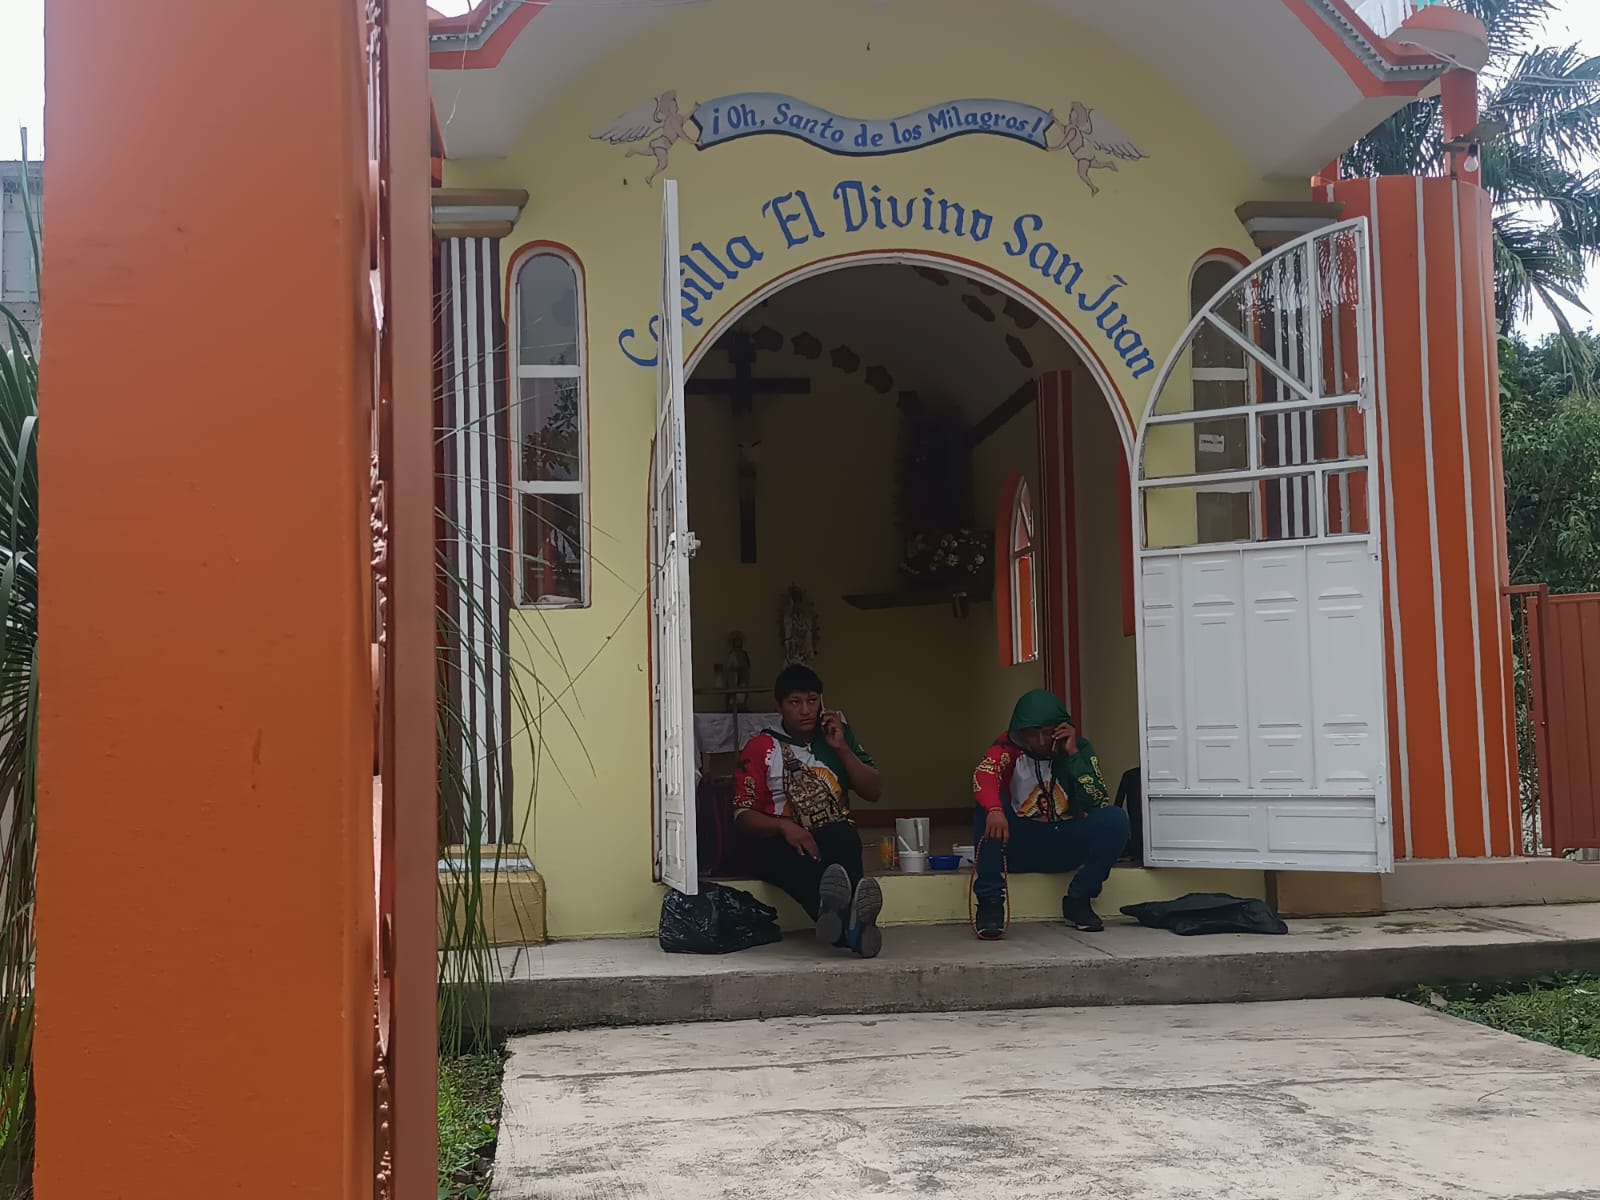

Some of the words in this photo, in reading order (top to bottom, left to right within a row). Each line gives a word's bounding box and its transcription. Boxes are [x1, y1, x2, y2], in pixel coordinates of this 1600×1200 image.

[772, 103, 845, 142] Santo
[854, 124, 883, 147] de
[890, 121, 922, 144] los
[928, 106, 1043, 138] Milagros!
[762, 190, 825, 249] El
[833, 180, 993, 242] Divino
[1002, 214, 1084, 295] San
[1078, 274, 1155, 379] Juan
